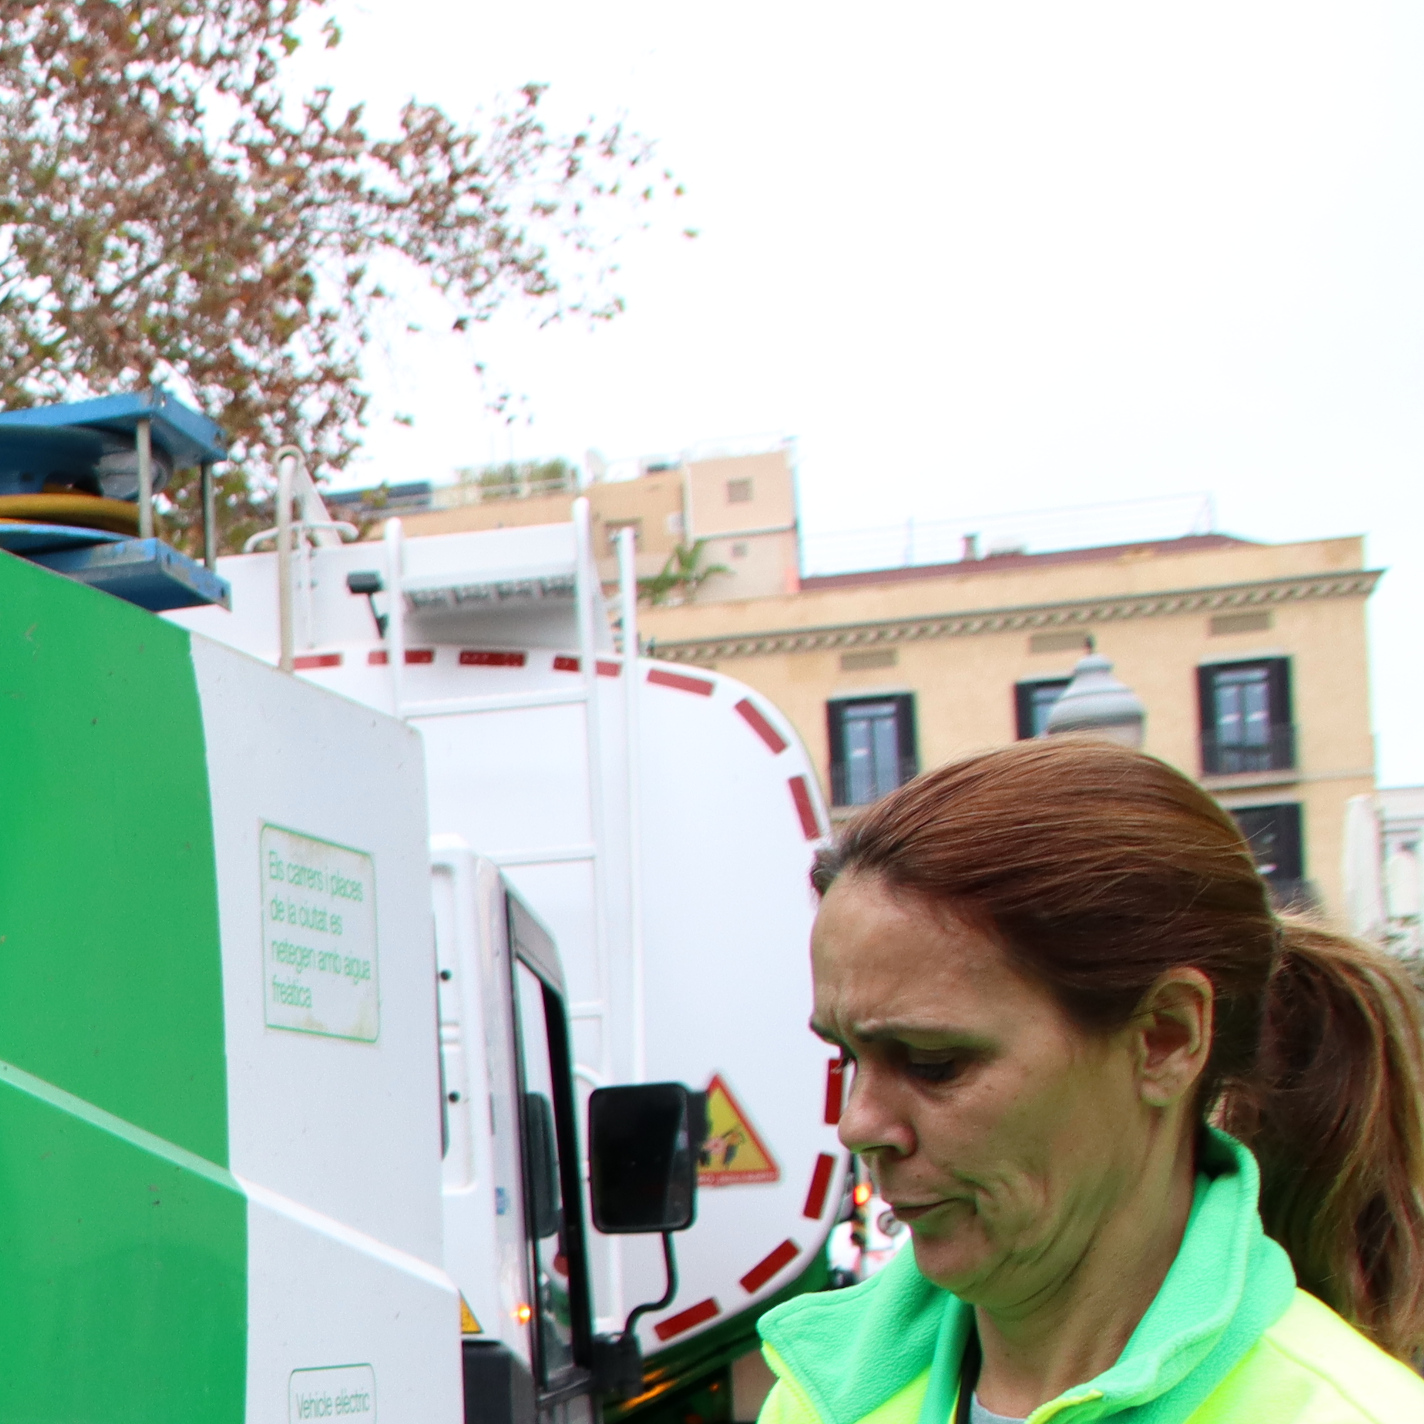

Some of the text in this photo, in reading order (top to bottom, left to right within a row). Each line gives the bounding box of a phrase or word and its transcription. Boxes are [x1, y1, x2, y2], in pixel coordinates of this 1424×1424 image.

[269, 849, 284, 881] Els
[286, 862, 324, 892] carrers
[330, 868, 364, 902] places
[270, 892, 343, 936] de la ciutat es
[271, 938, 371, 985] netegen amb aigua
[295, 1390, 332, 1420] Vehicle
